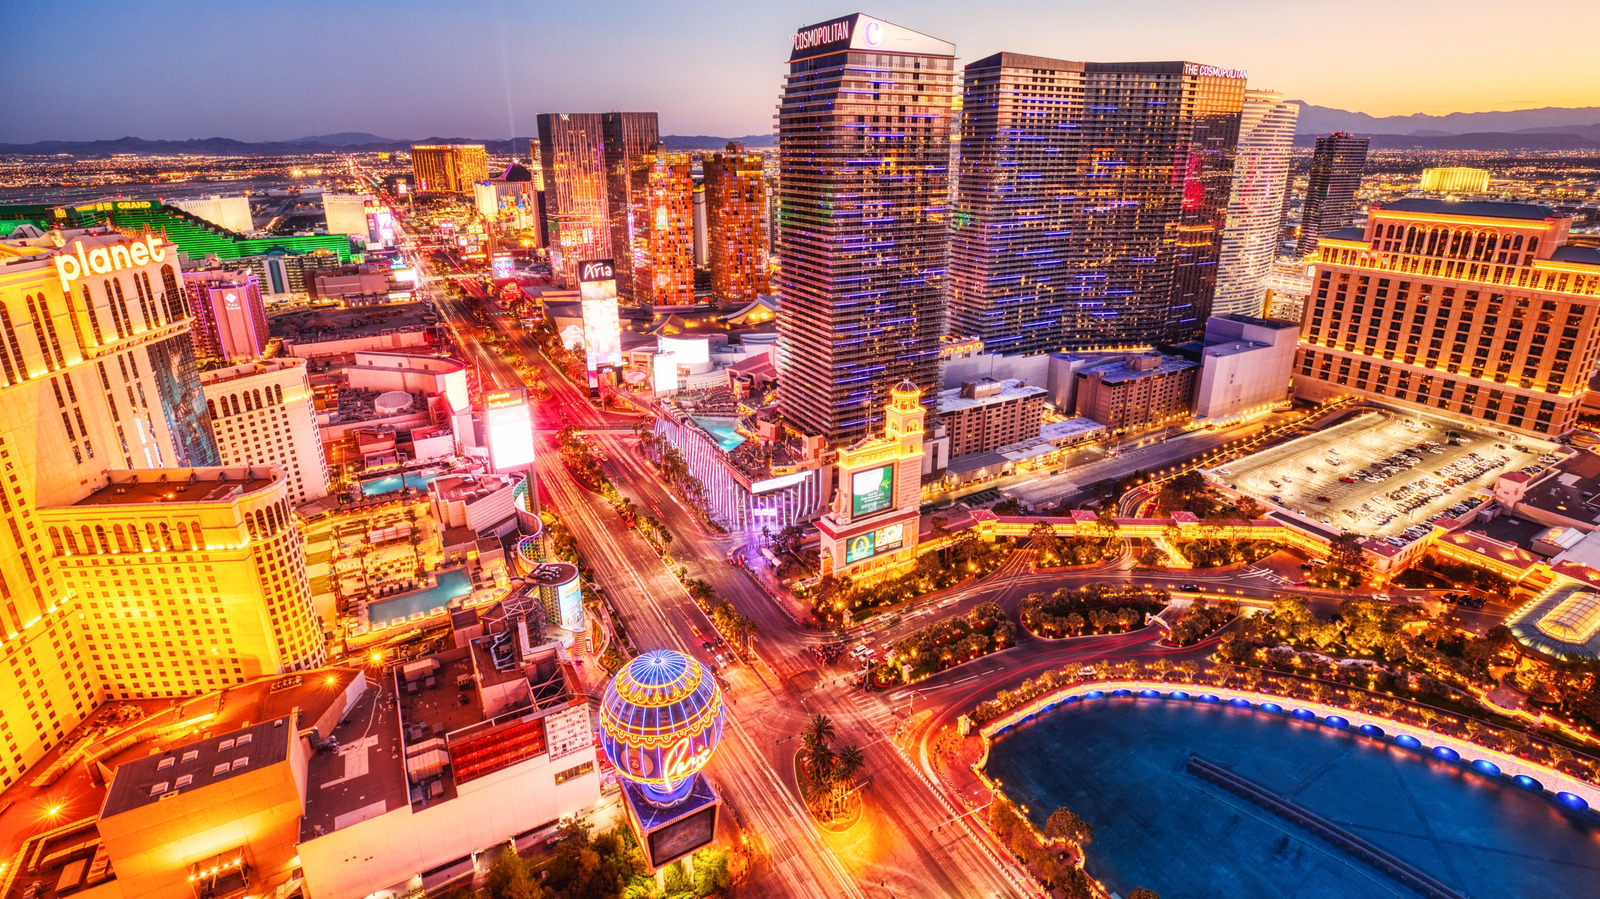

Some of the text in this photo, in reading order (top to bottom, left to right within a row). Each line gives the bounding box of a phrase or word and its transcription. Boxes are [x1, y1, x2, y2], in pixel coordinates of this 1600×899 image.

[795, 21, 849, 51] COSMOPOLITAN
[1184, 64, 1249, 80] THE COSMOPOLITAN
[117, 200, 152, 209] GRAND
[364, 206, 391, 215] MGM
[54, 234, 166, 292] planet
[584, 262, 612, 280] Aria
[488, 392, 510, 402] planet
[488, 398, 522, 409] hollywood
[664, 737, 711, 793] Paris
